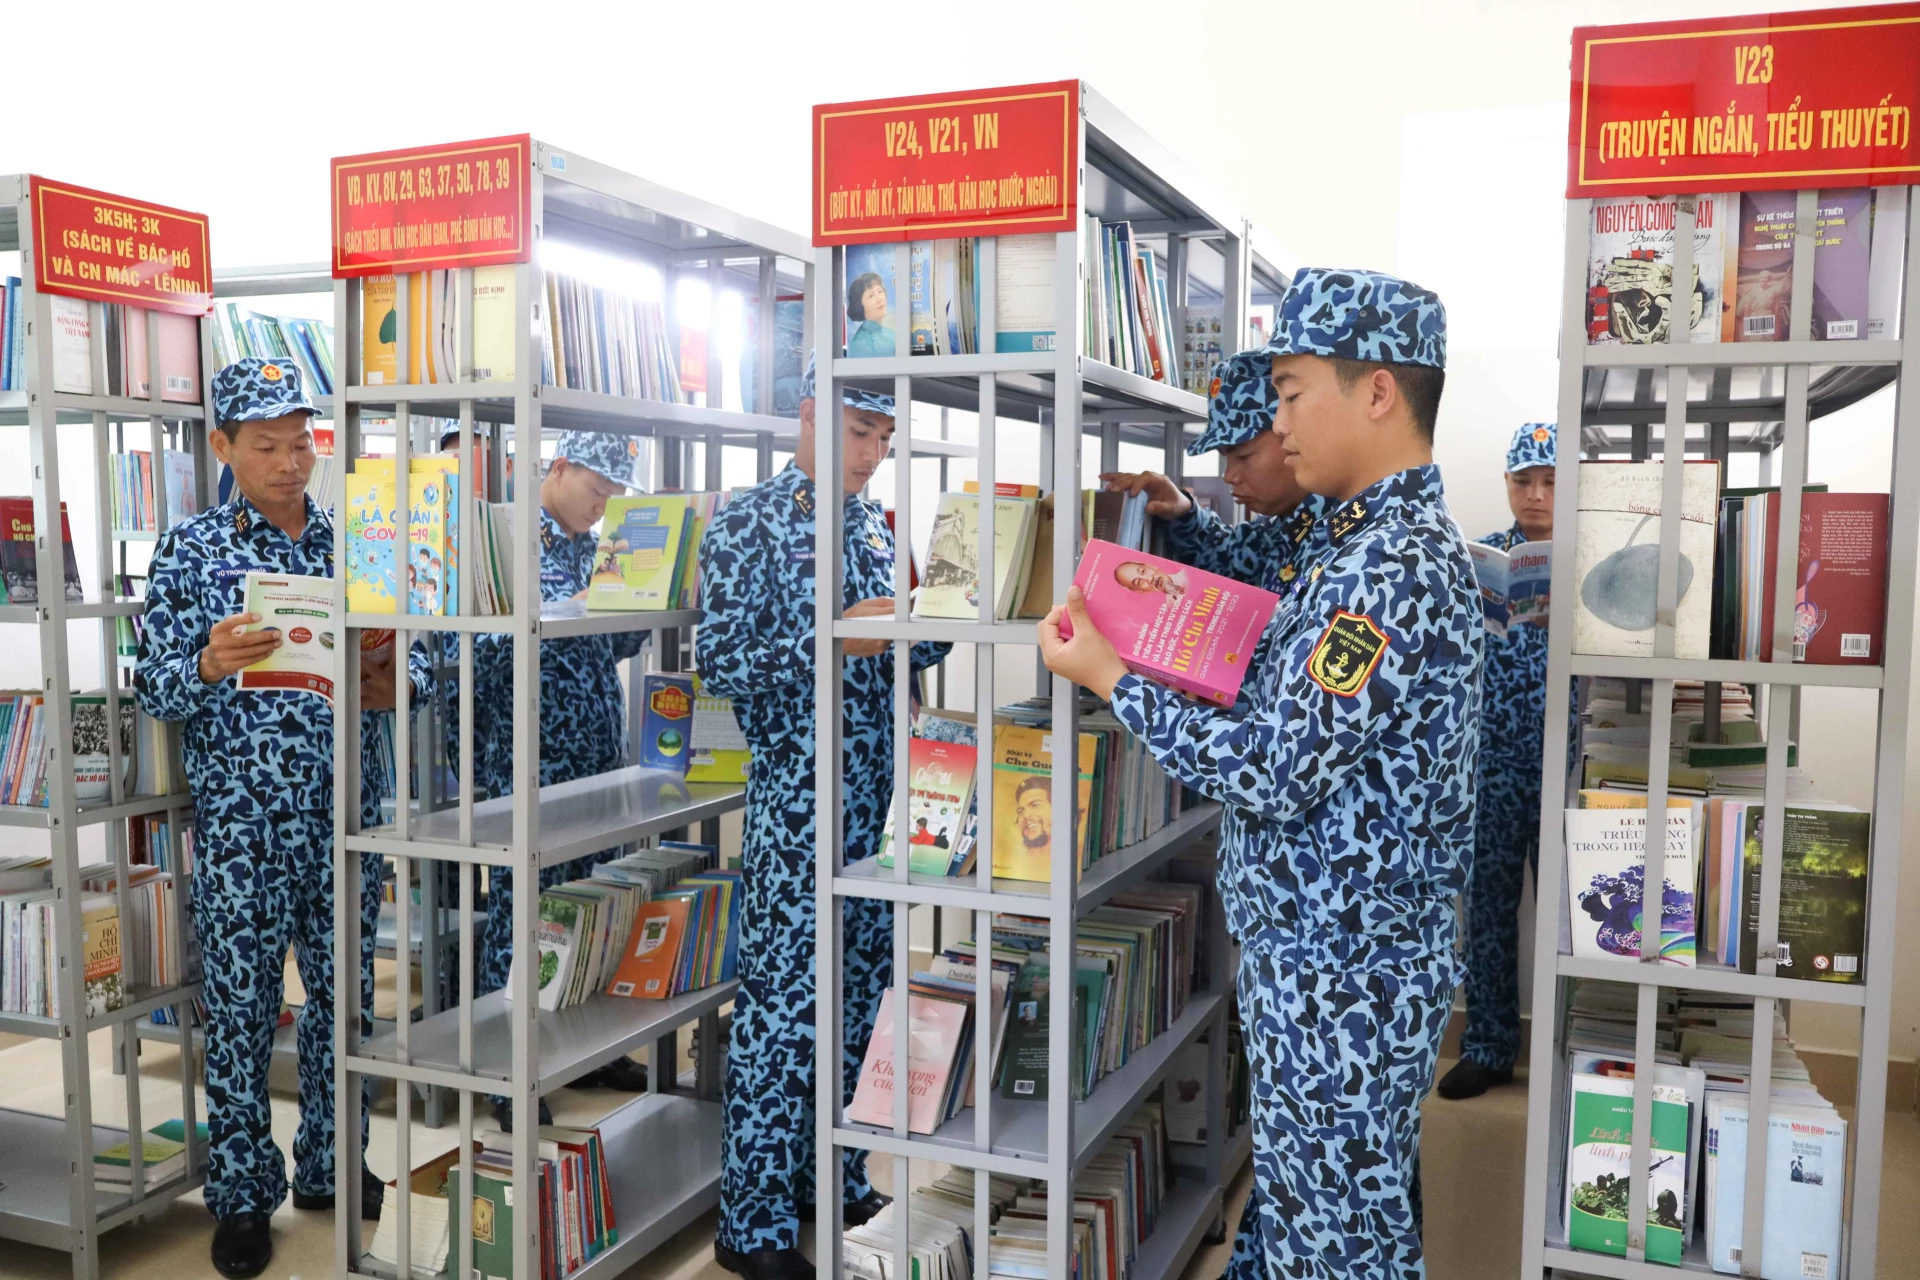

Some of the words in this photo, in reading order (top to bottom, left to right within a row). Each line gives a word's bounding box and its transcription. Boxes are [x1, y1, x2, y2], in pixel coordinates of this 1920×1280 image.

[1735, 44, 1774, 85] V23
[885, 121, 922, 159] V24,
[928, 116, 967, 155] V21,
[973, 112, 998, 150] VN
[1599, 110, 1686, 165] (TRUYỆN
[1692, 100, 1758, 157] NGẮN,
[1766, 95, 1814, 152] TIỂU
[1820, 94, 1910, 150] THUYẾT)
[367, 173, 382, 206] KV,
[384, 171, 398, 204] 8V,
[400, 169, 416, 203] 29,
[419, 167, 434, 200] 63,
[438, 164, 453, 198] 37,
[457, 162, 473, 196] 50,
[476, 160, 492, 194] 78,
[496, 157, 510, 189] 39
[830, 185, 848, 222] (BÚT
[850, 184, 863, 221] KÝ,
[882, 181, 895, 219] KÝ,
[979, 180, 997, 215] HỌC
[999, 172, 1024, 207] NƯỚC
[1026, 169, 1057, 207] NGOÀI)
[94, 206, 137, 233] 3K5H;
[142, 217, 160, 236] 3K
[1596, 200, 1643, 234] NGUYỄN
[63, 230, 111, 254] (SÁCH
[116, 236, 134, 259] VỀ
[139, 242, 168, 264] BÁC
[172, 247, 190, 269] HỒ
[52, 254, 74, 277] VÀ
[79, 261, 101, 281] CN
[106, 266, 140, 288] MÁC
[154, 272, 200, 297] LÊNIN)
[1350, 644, 1361, 653] NAM
[1006, 757, 1028, 766] Che
[1572, 842, 1619, 851] TRONG
[90, 946, 118, 961] MINH
